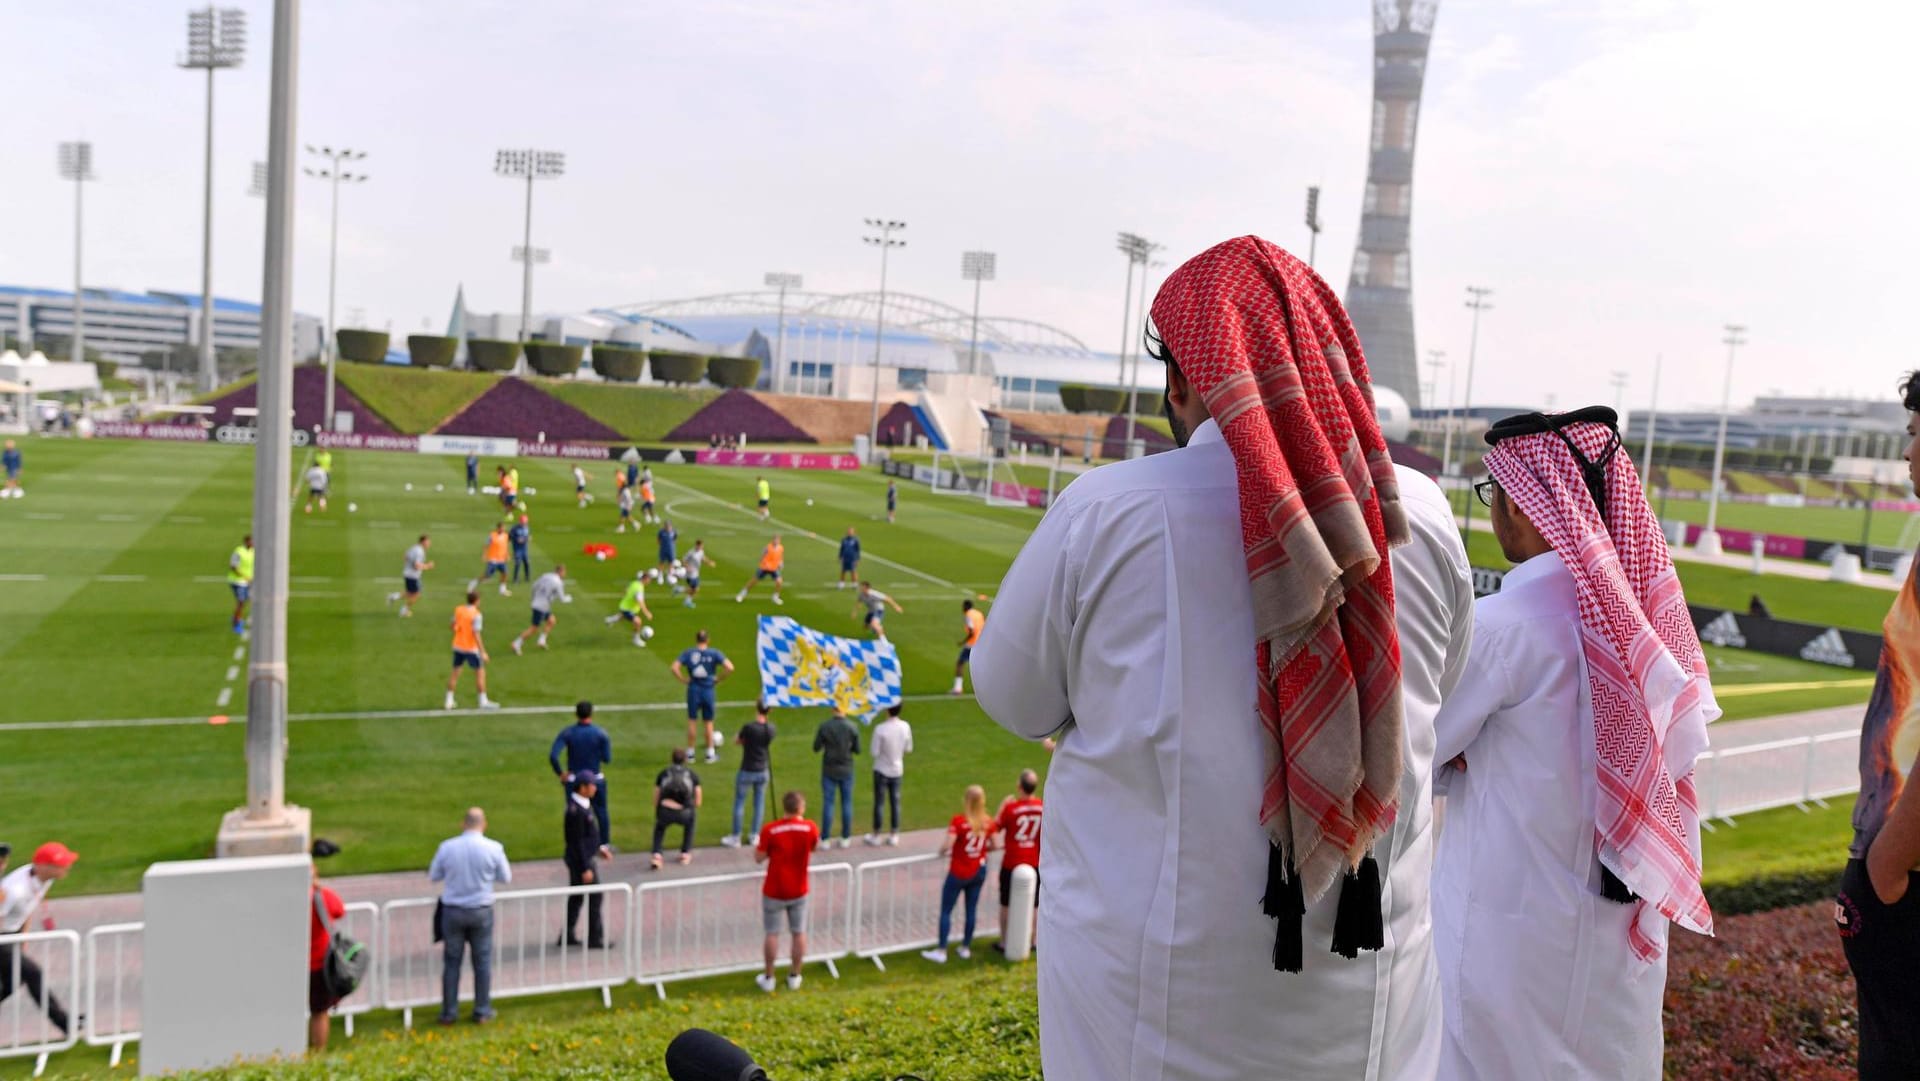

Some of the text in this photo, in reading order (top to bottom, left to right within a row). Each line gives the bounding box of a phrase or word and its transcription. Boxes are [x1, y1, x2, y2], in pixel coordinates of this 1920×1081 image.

[95, 423, 209, 440] QATAR AIRWAYS
[317, 431, 418, 450] QATAR AIRWAYS
[443, 440, 479, 450] Allianz
[518, 442, 609, 459] QATAR AIRWAYS
[1015, 815, 1041, 840] 27
